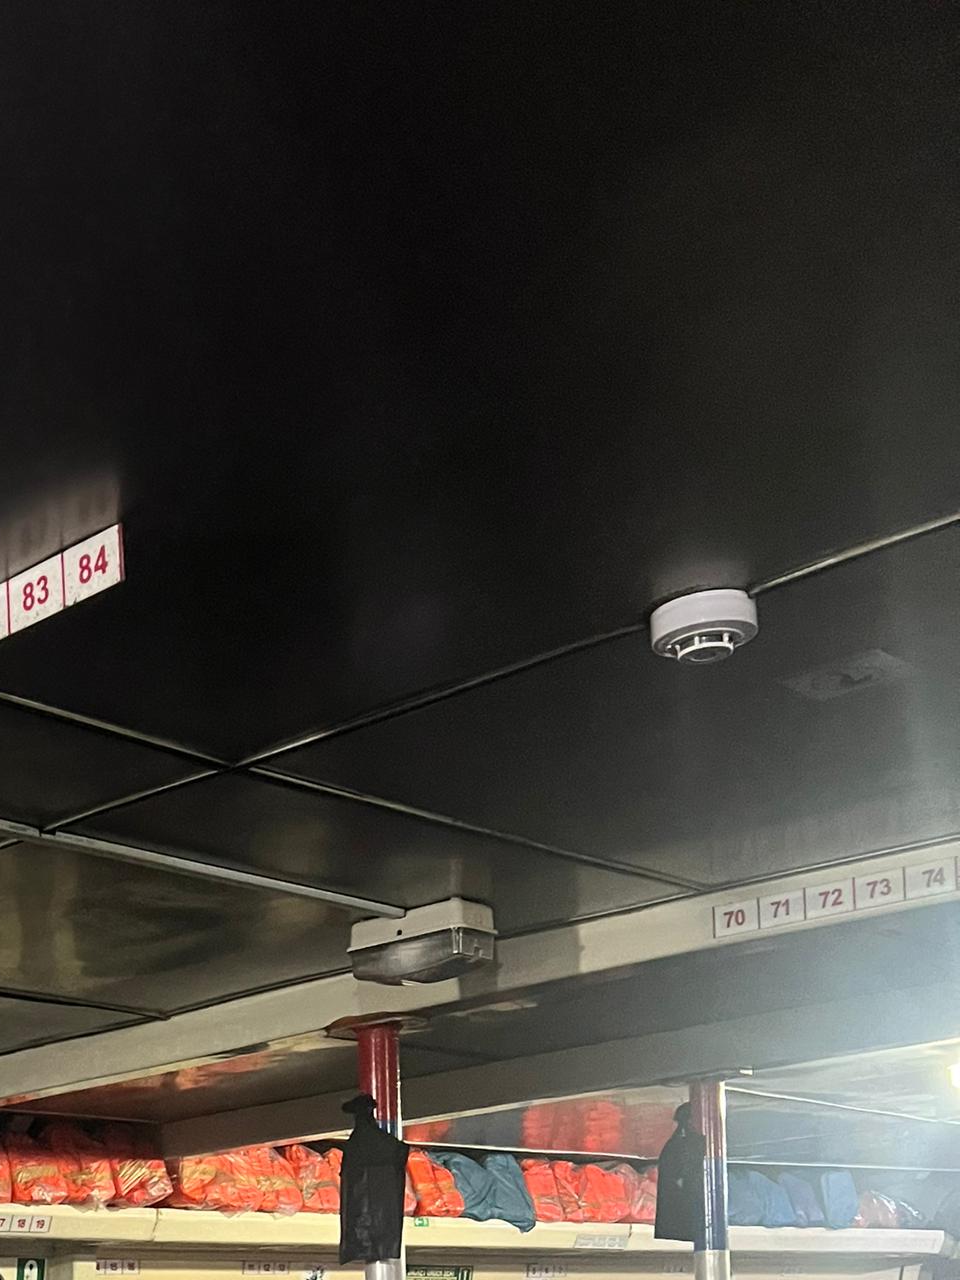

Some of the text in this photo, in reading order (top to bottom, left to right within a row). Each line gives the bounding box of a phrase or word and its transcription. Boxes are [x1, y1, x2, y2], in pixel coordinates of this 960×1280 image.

[22, 575, 49, 611] 83
[79, 545, 108, 583] 84
[723, 867, 946, 928] 70 71 72 73 74
